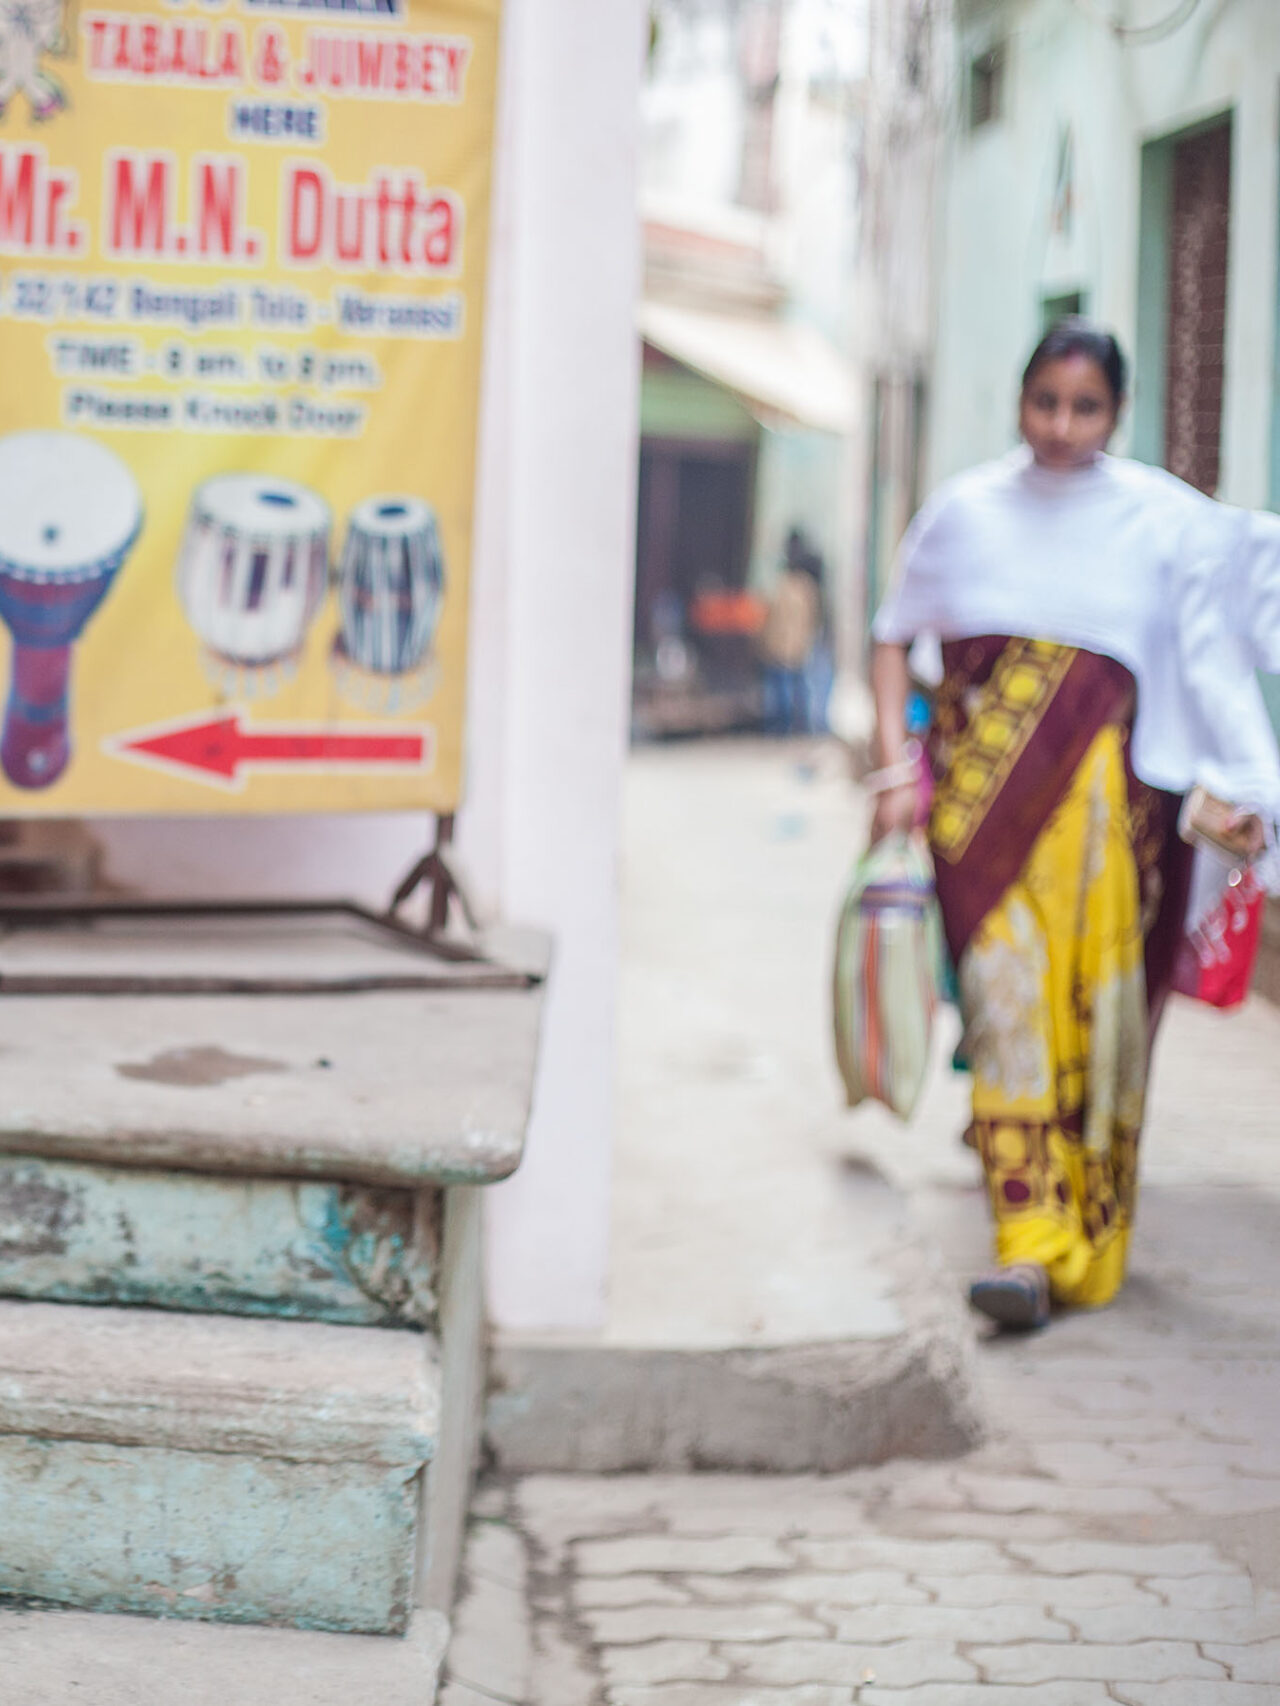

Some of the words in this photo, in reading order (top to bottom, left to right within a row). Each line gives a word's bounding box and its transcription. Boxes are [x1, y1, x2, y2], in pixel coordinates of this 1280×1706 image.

[88, 20, 242, 77] TABALA
[258, 31, 286, 85] &
[233, 105, 321, 139] HERE
[113, 158, 259, 257] M.N.
[290, 169, 454, 266] Dutta
[129, 282, 239, 326] Bengali
[250, 287, 308, 323] Tola
[54, 340, 134, 371] TIME
[261, 351, 288, 376] to
[69, 390, 174, 420] Please
[185, 396, 279, 425] Knock
[288, 399, 363, 427] Door
